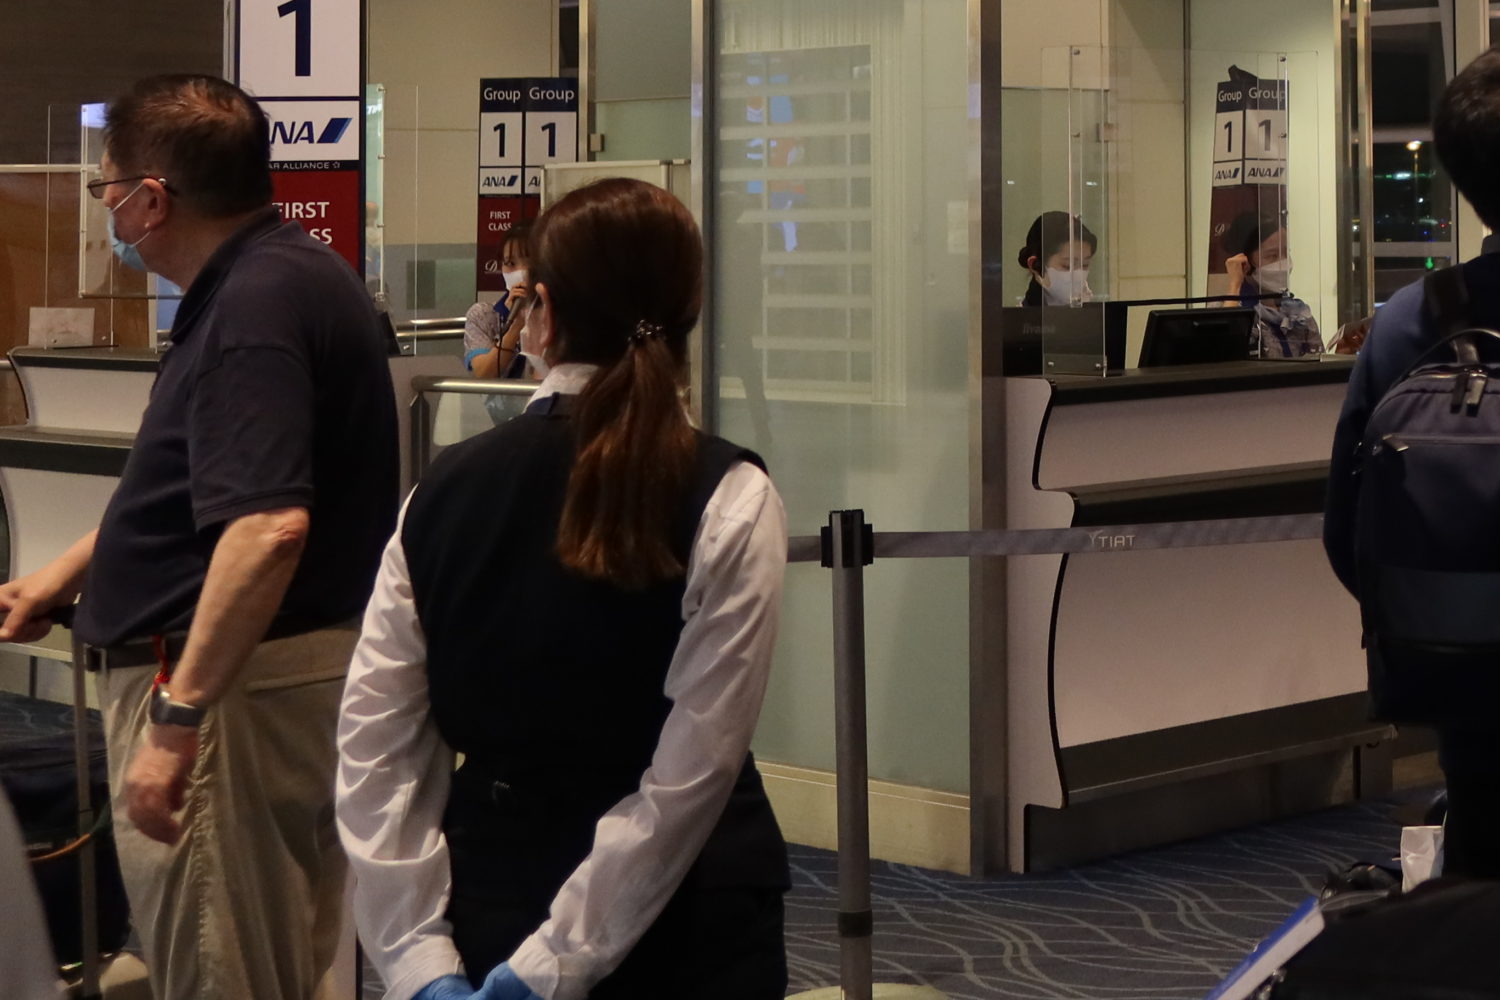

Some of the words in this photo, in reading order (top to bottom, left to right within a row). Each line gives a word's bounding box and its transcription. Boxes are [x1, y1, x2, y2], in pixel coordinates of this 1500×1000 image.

[483, 87, 521, 103] Group
[528, 86, 575, 103] Group
[1218, 89, 1242, 103] Group
[1248, 86, 1286, 102] Group
[270, 120, 316, 145] NA
[493, 122, 505, 158] 1
[541, 122, 556, 158] 1
[1224, 120, 1233, 152] 1
[1258, 119, 1272, 151] 1
[283, 161, 330, 169] ALLIANCE
[1247, 167, 1272, 178] ANA
[482, 176, 507, 187] ANA
[1215, 169, 1232, 180] ANA
[489, 211, 511, 220] FIRST
[1098, 534, 1136, 548] TIAT
